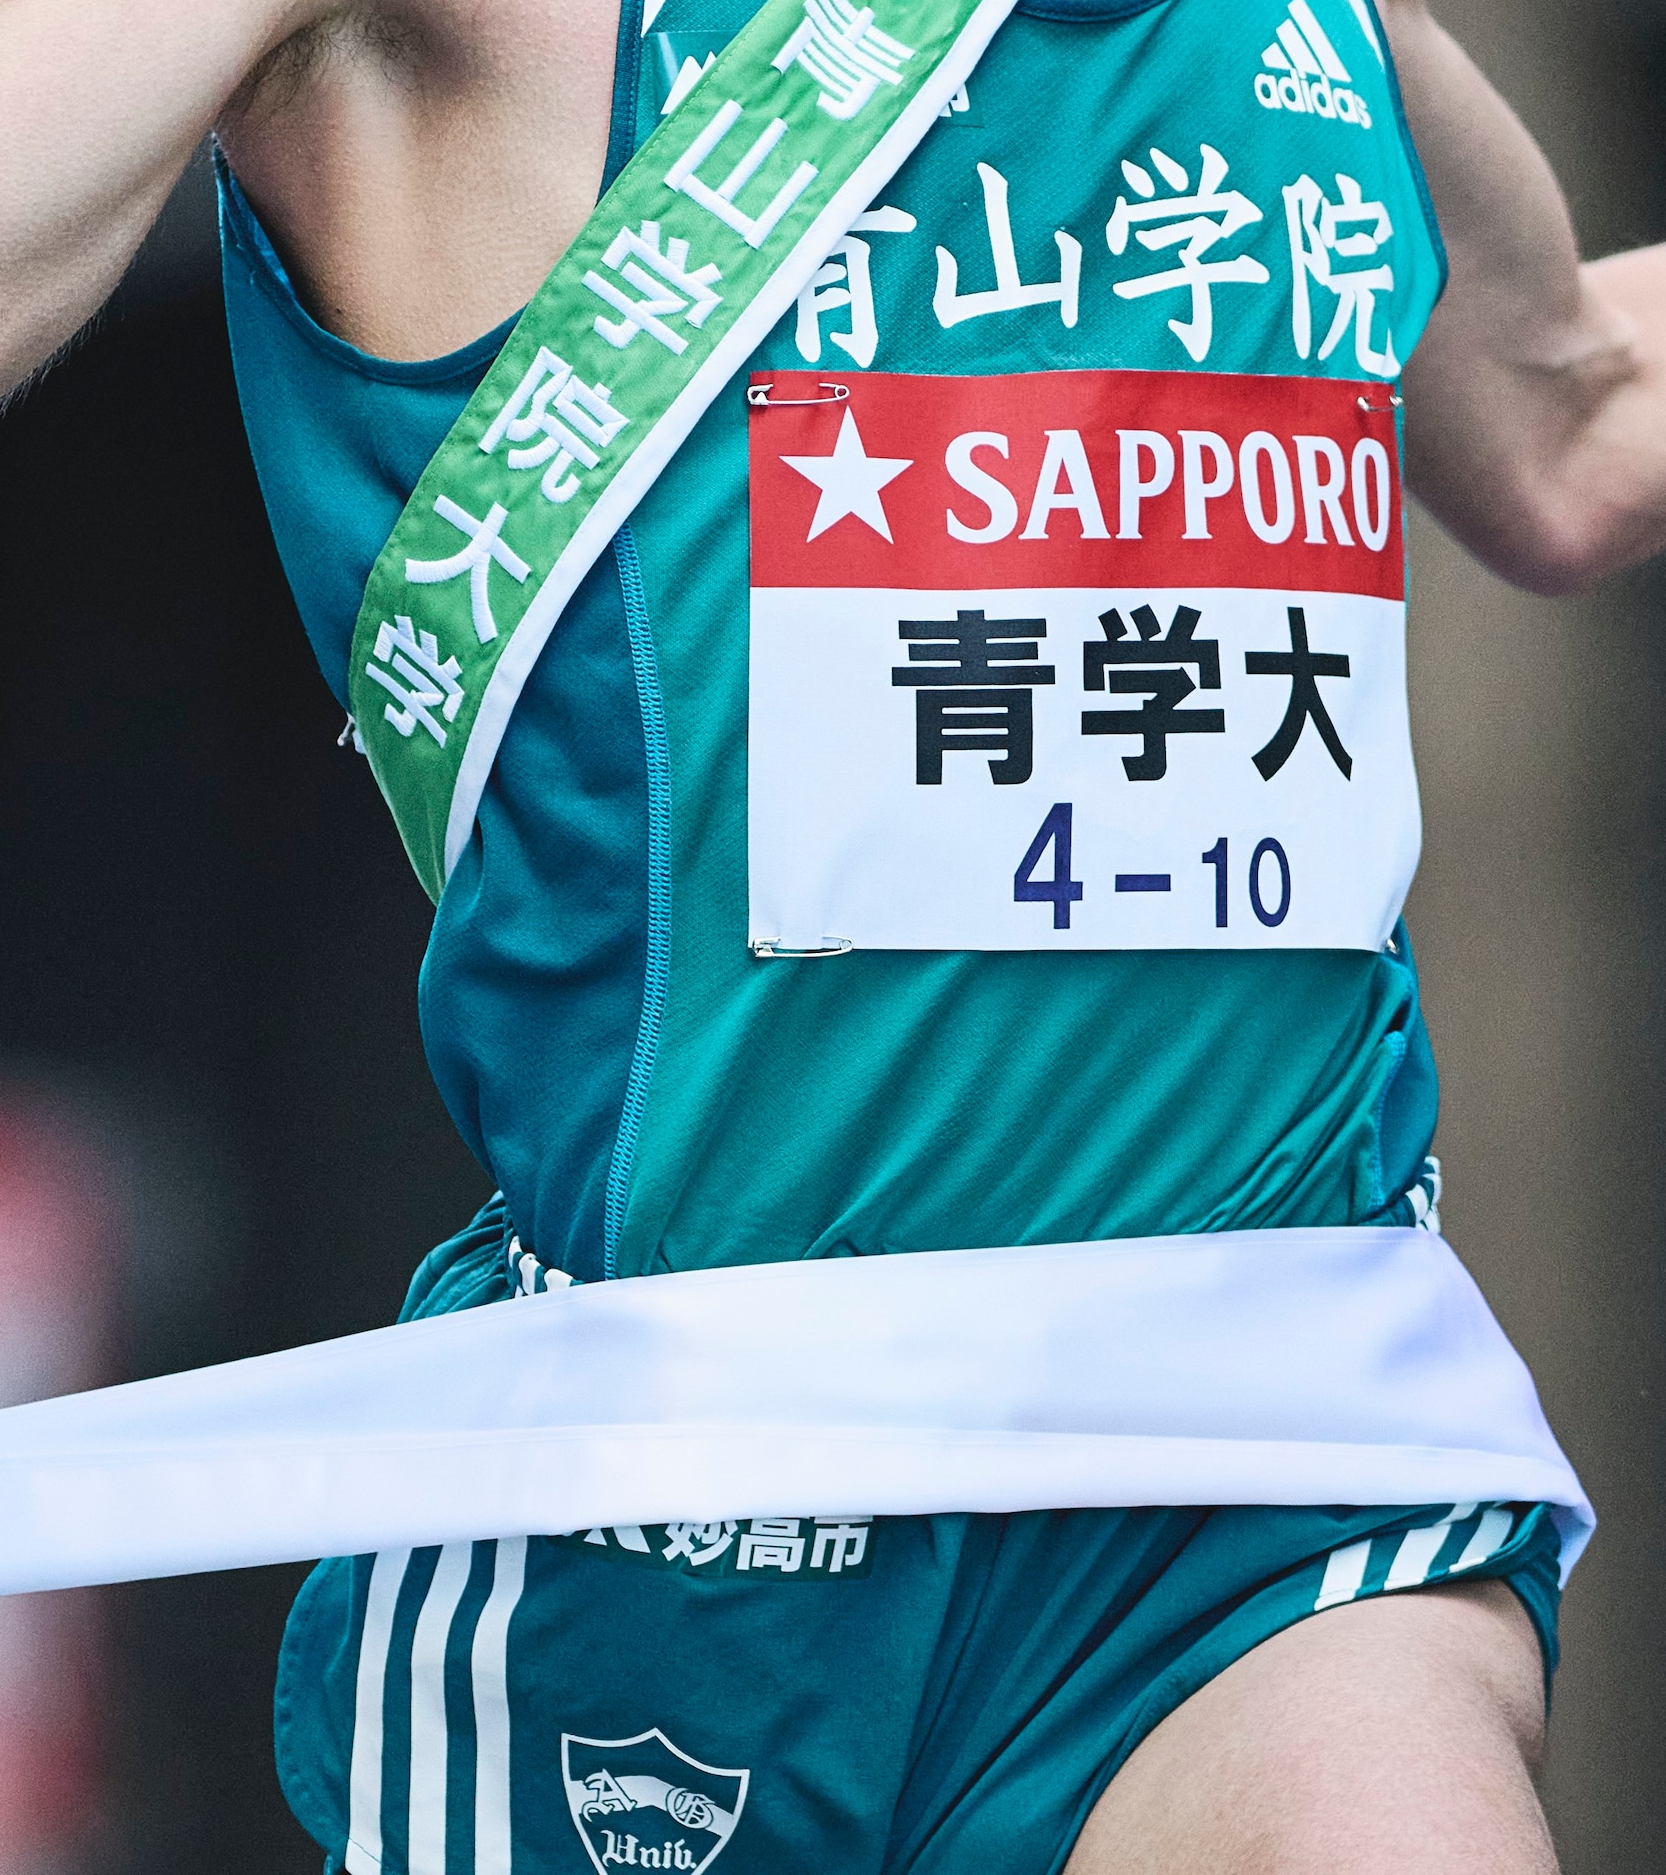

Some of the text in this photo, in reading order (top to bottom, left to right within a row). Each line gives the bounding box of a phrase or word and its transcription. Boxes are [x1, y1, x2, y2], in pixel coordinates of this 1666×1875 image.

[1253, 67, 1373, 129] adidas
[944, 428, 1390, 553] SAPPORO
[890, 604, 1354, 786] 青学大
